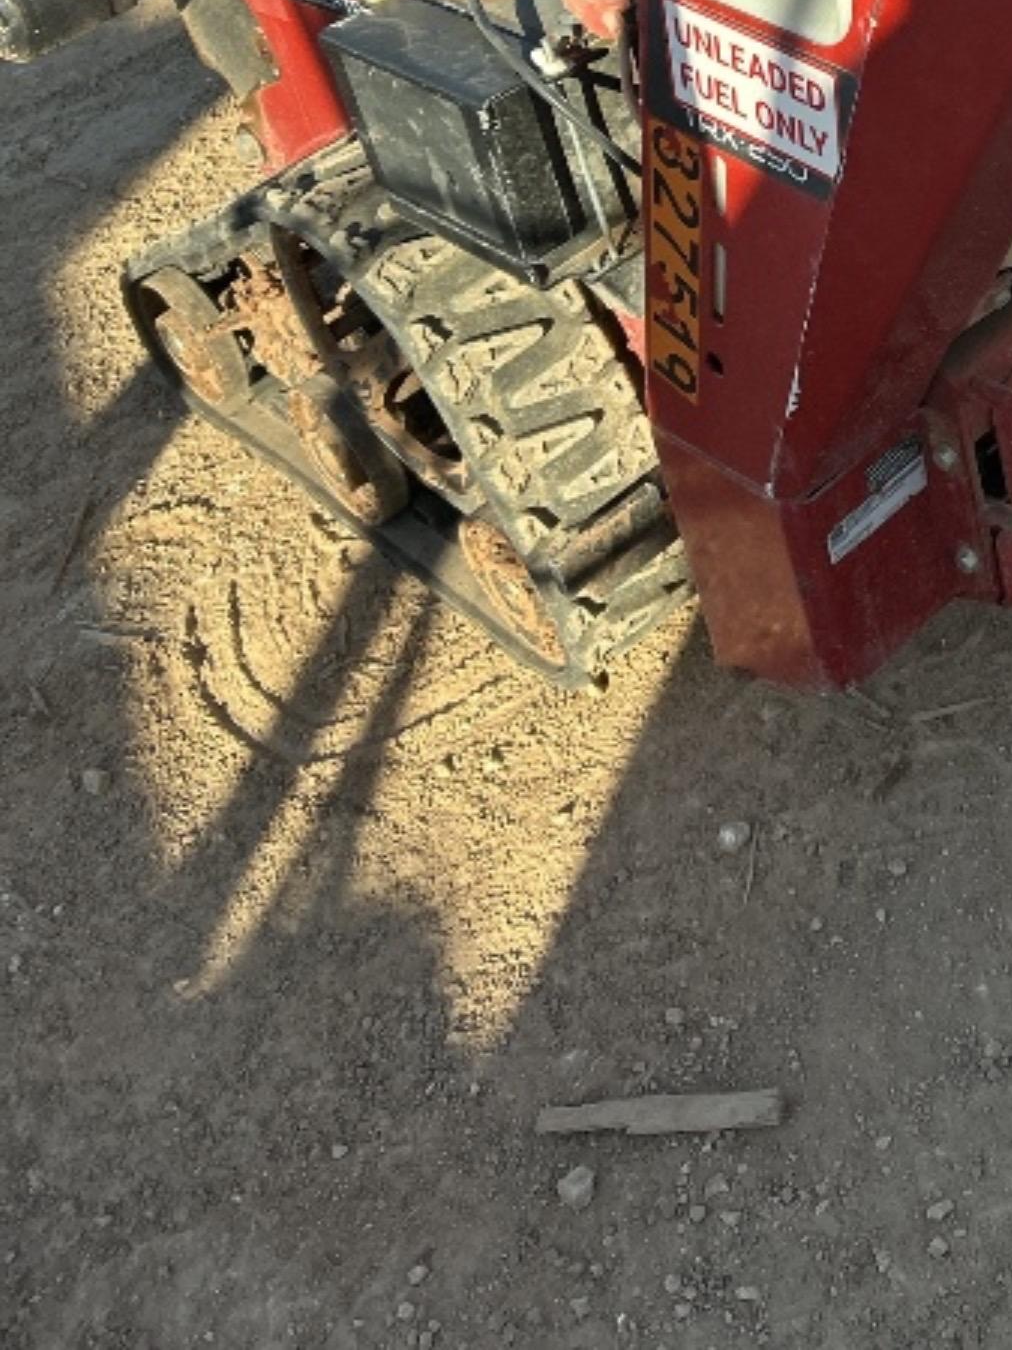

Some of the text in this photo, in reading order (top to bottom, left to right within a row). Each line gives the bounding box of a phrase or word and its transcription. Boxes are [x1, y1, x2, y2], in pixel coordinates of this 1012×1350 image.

[673, 16, 827, 112] UNLEADED
[679, 61, 829, 157] FUEL ONLY
